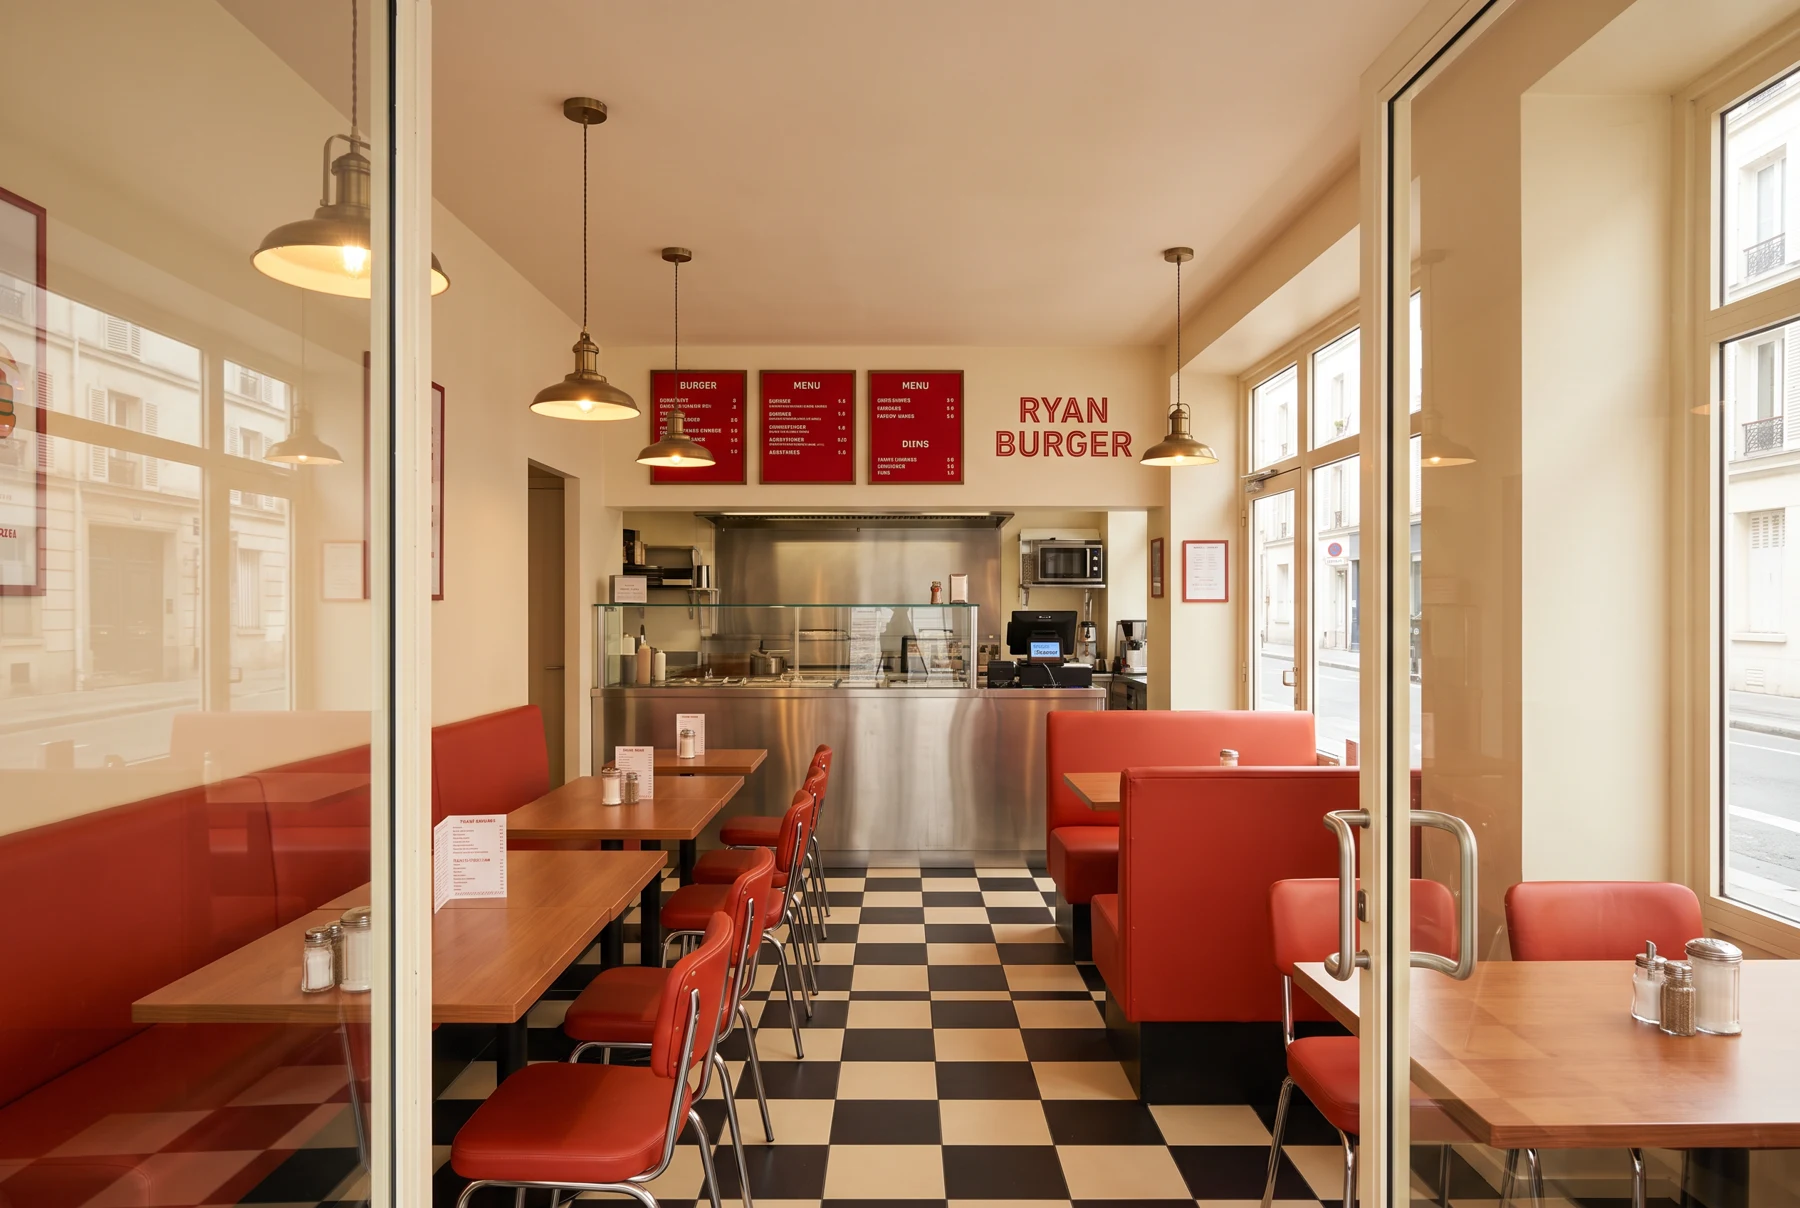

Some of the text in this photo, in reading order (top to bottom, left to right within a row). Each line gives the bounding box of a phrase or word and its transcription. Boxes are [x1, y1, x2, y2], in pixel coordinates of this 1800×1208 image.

[680, 381, 717, 390] BURGER
[793, 381, 821, 390] MENU
[902, 381, 929, 390] MENU
[1019, 397, 1108, 423] RYAN
[996, 430, 1132, 457] BURGER
